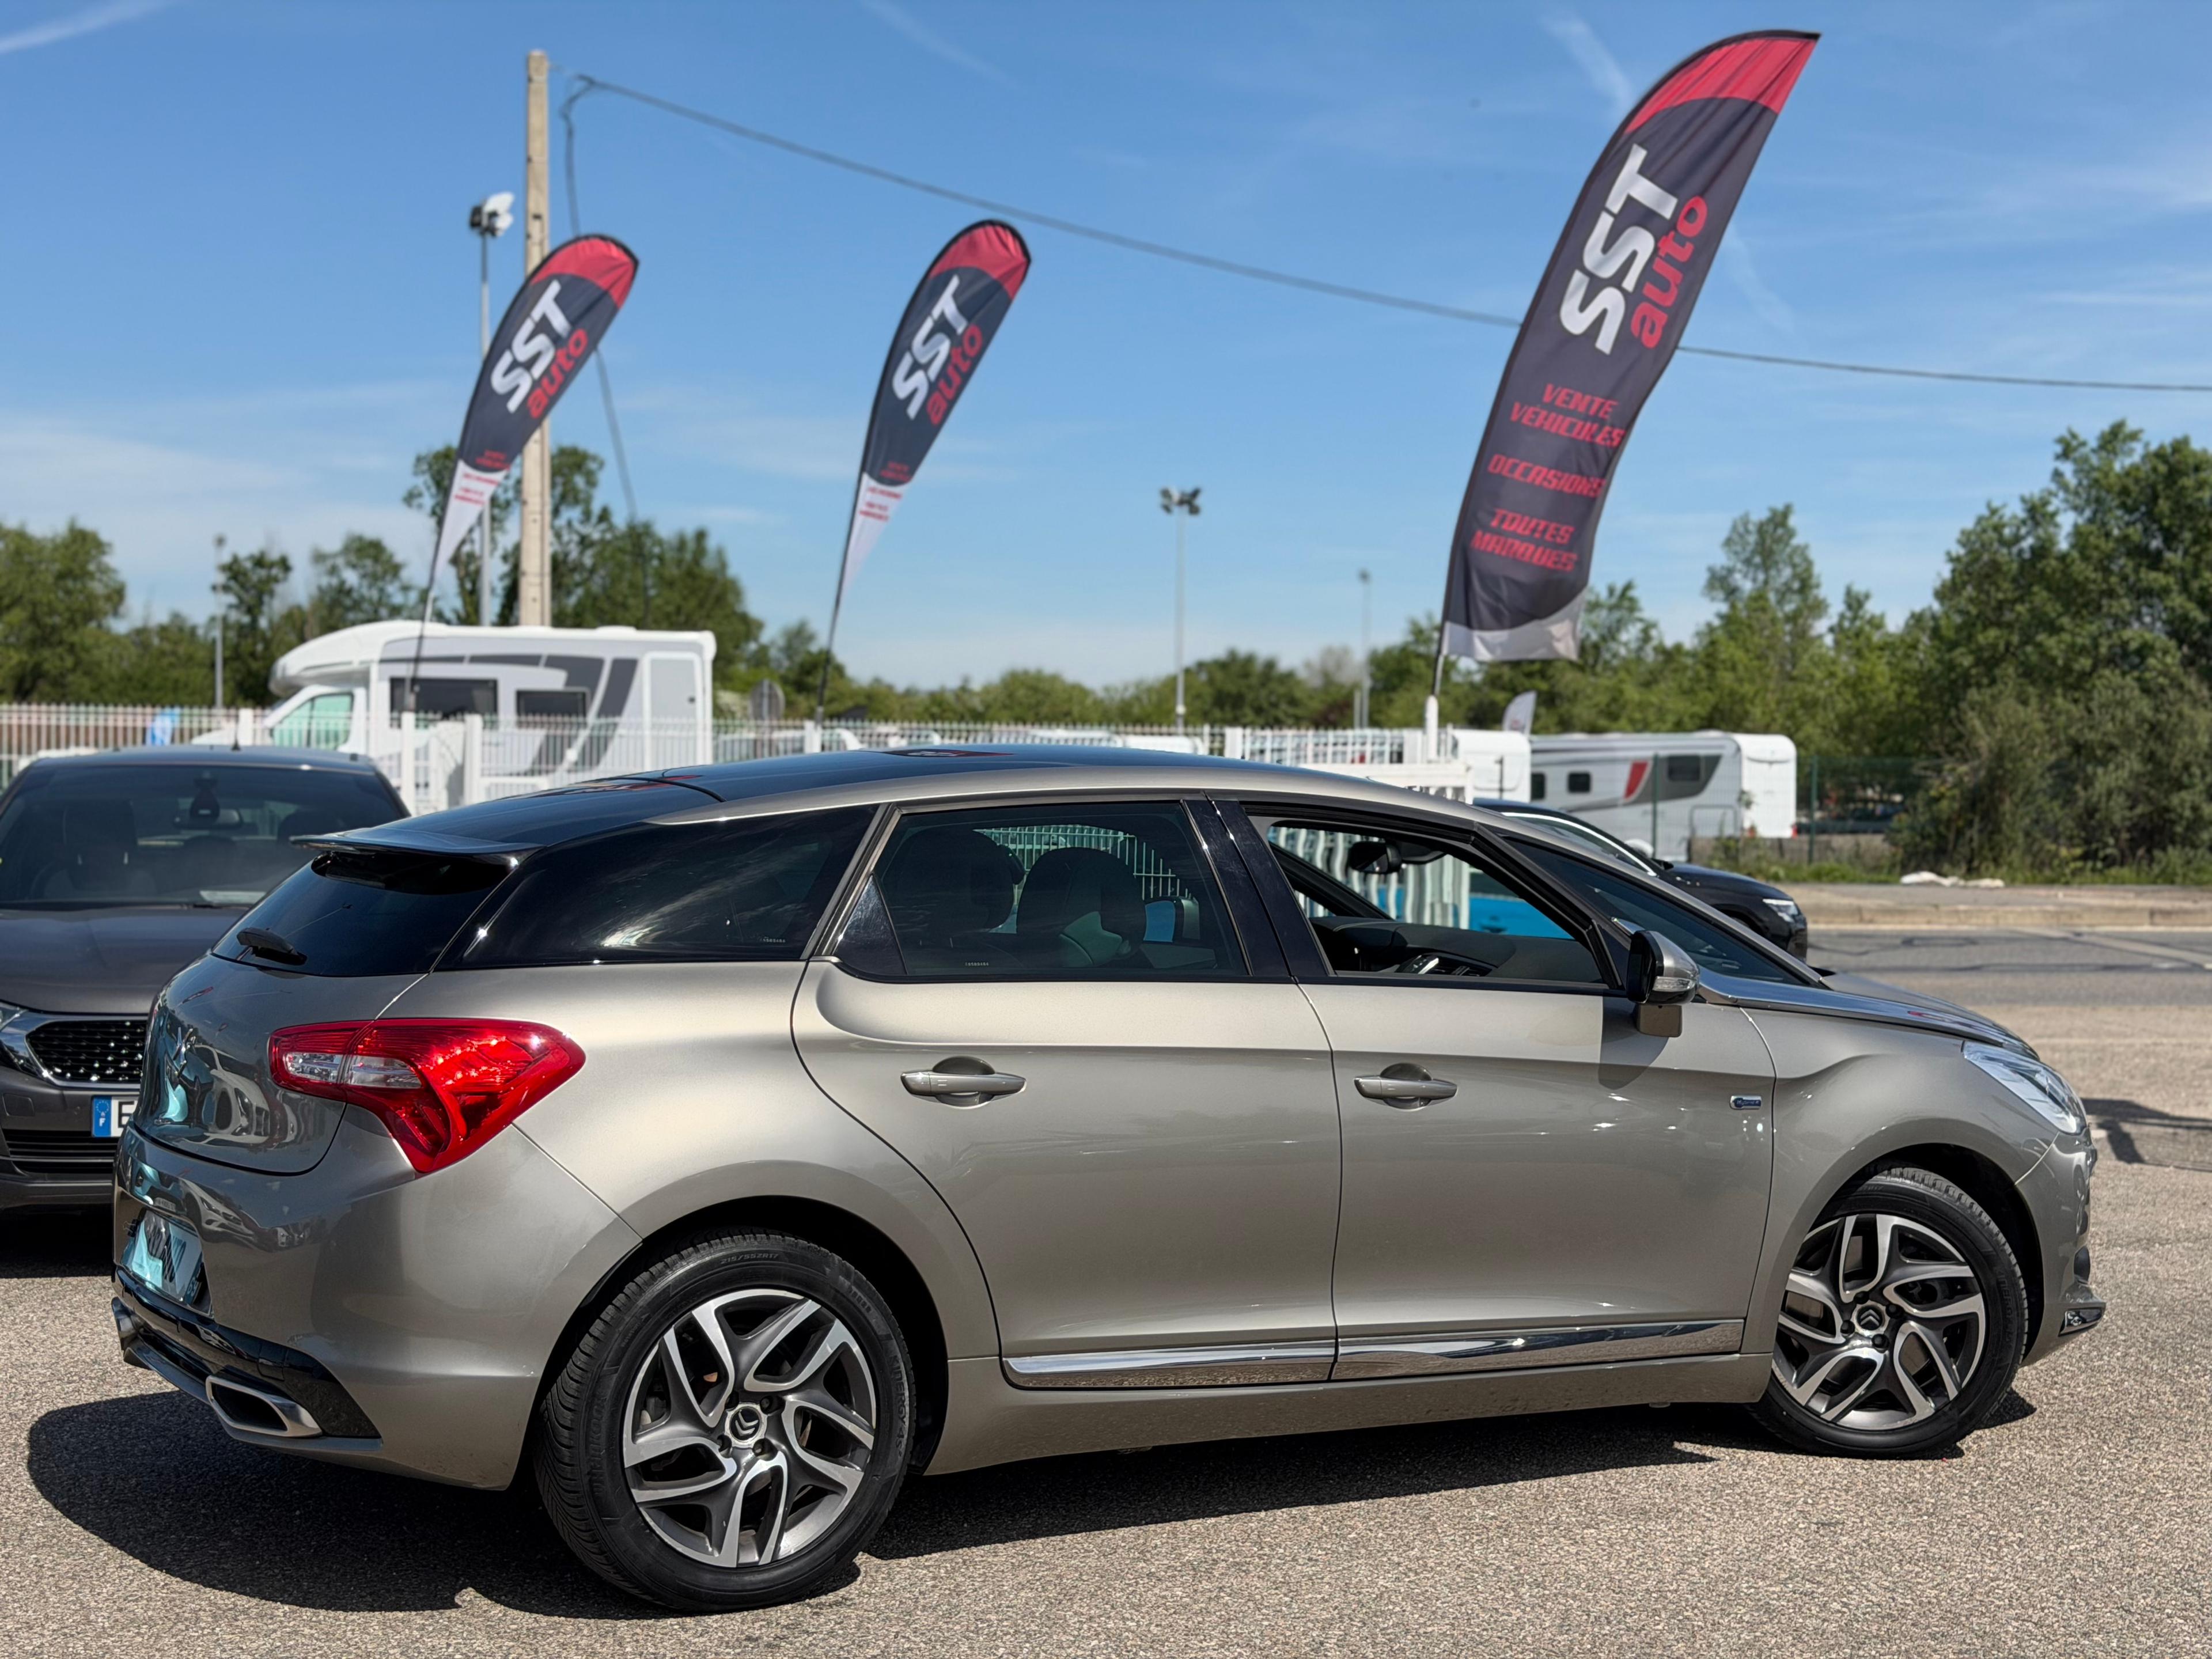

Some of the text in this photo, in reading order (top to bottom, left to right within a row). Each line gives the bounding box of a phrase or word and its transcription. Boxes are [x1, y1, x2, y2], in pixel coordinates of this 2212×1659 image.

[1559, 143, 1679, 355] SST
[1630, 196, 1708, 349] auto
[490, 279, 571, 414] SST
[527, 329, 588, 418] auto
[892, 274, 967, 419] SST
[925, 324, 983, 425] auto
[1543, 383, 1618, 420] VENTE
[1487, 454, 1606, 498] OCCASIONS
[1471, 529, 1578, 571] MARQUES
[1490, 507, 1575, 544] TOUTES
[99, 1118, 106, 1127] F
